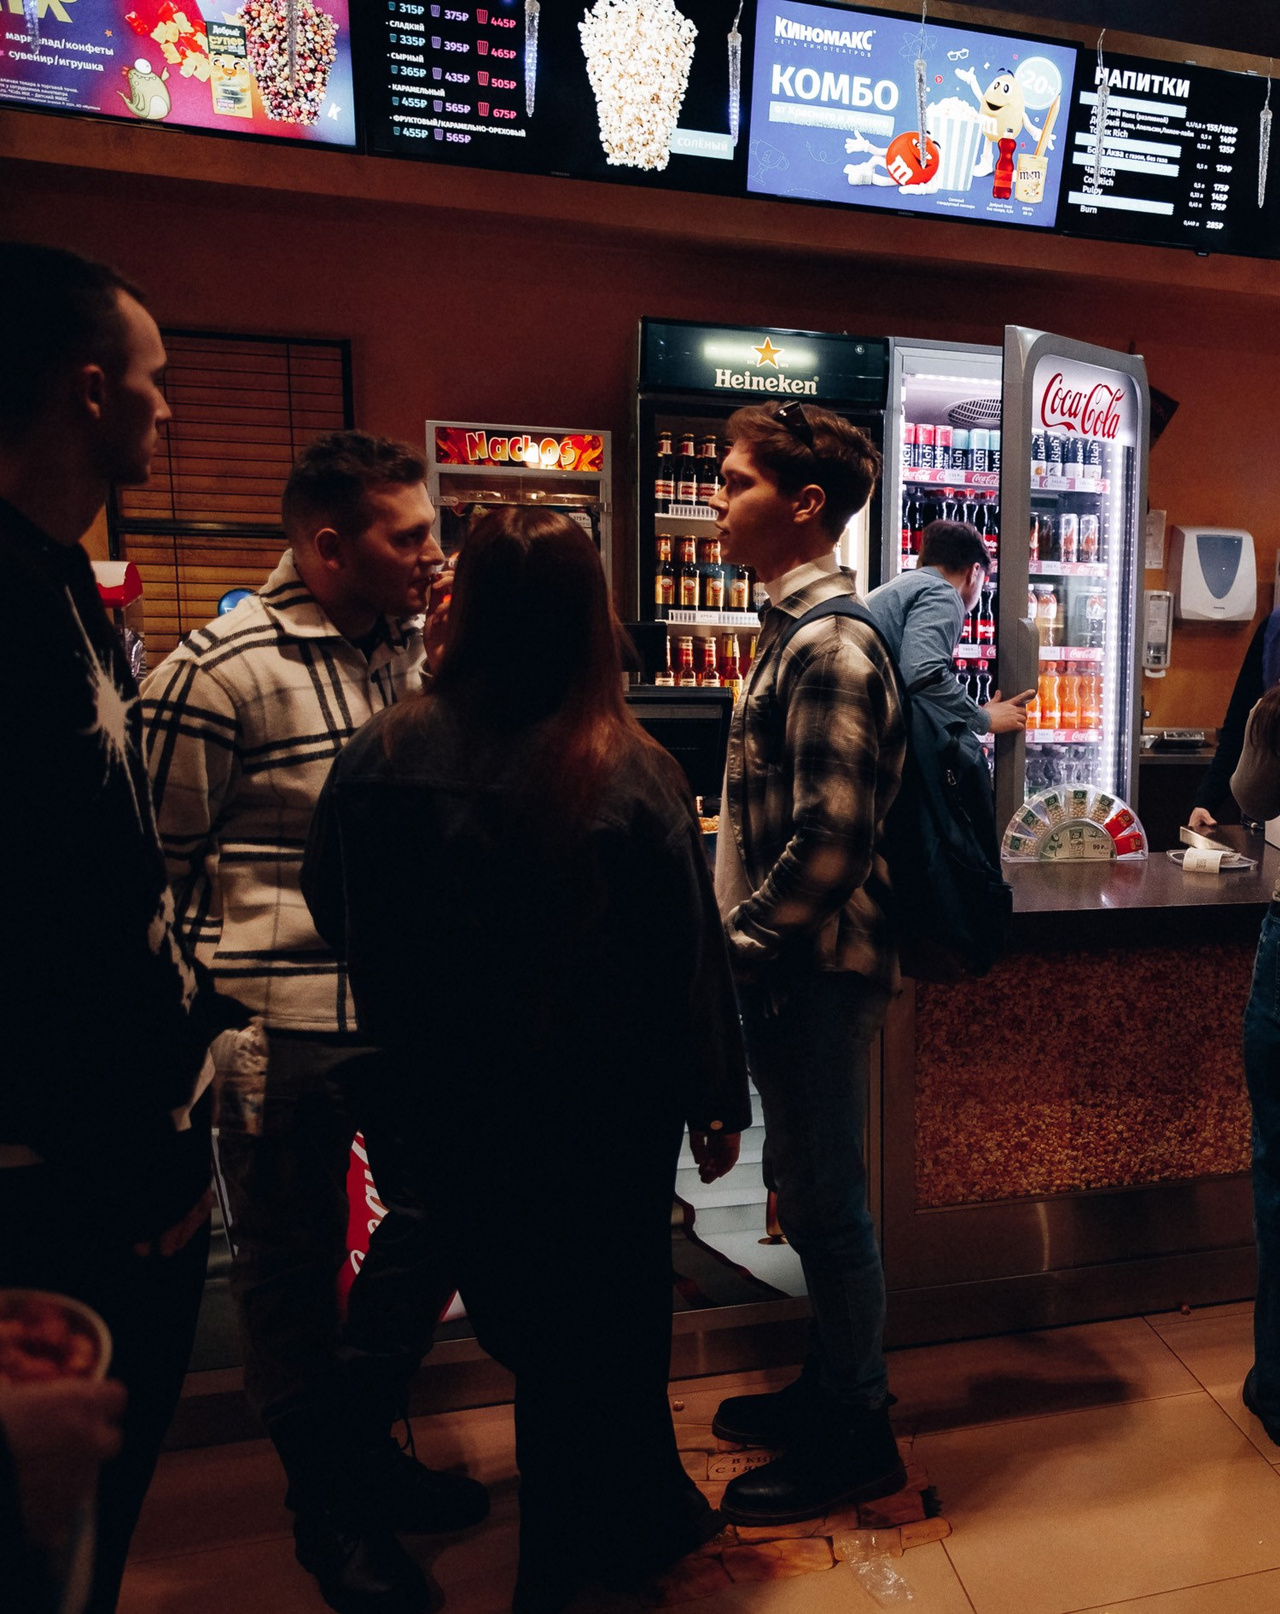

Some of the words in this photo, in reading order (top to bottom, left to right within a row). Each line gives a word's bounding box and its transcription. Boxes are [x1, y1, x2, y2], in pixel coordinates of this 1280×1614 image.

[389, 20, 425, 32] СЛАДКИЙ
[775, 15, 873, 51] КИНОМАКС
[774, 38, 797, 47] СЕТЬ
[804, 43, 872, 58] КИНОТЕАТРОВ
[391, 52, 424, 63] СЫРНЫЙ
[771, 64, 899, 111] КОМБО
[1094, 66, 1191, 99] НАПИТКИ
[392, 84, 445, 97] КАРАМЕЛЬНЫЙ
[1090, 105, 1121, 118] Дрый
[1089, 125, 1112, 137] Тоик
[1112, 128, 1128, 138] Rich
[1087, 145, 1105, 156] Боа
[1106, 147, 1124, 158] Аква
[1100, 167, 1116, 177] Rich
[1099, 177, 1114, 187] Rich
[1082, 185, 1103, 196] Pulpy
[1080, 205, 1098, 214] Burn
[714, 368, 819, 395] Heineken
[1040, 372, 1126, 440] Coca-Cola
[466, 430, 576, 467] Nachos
